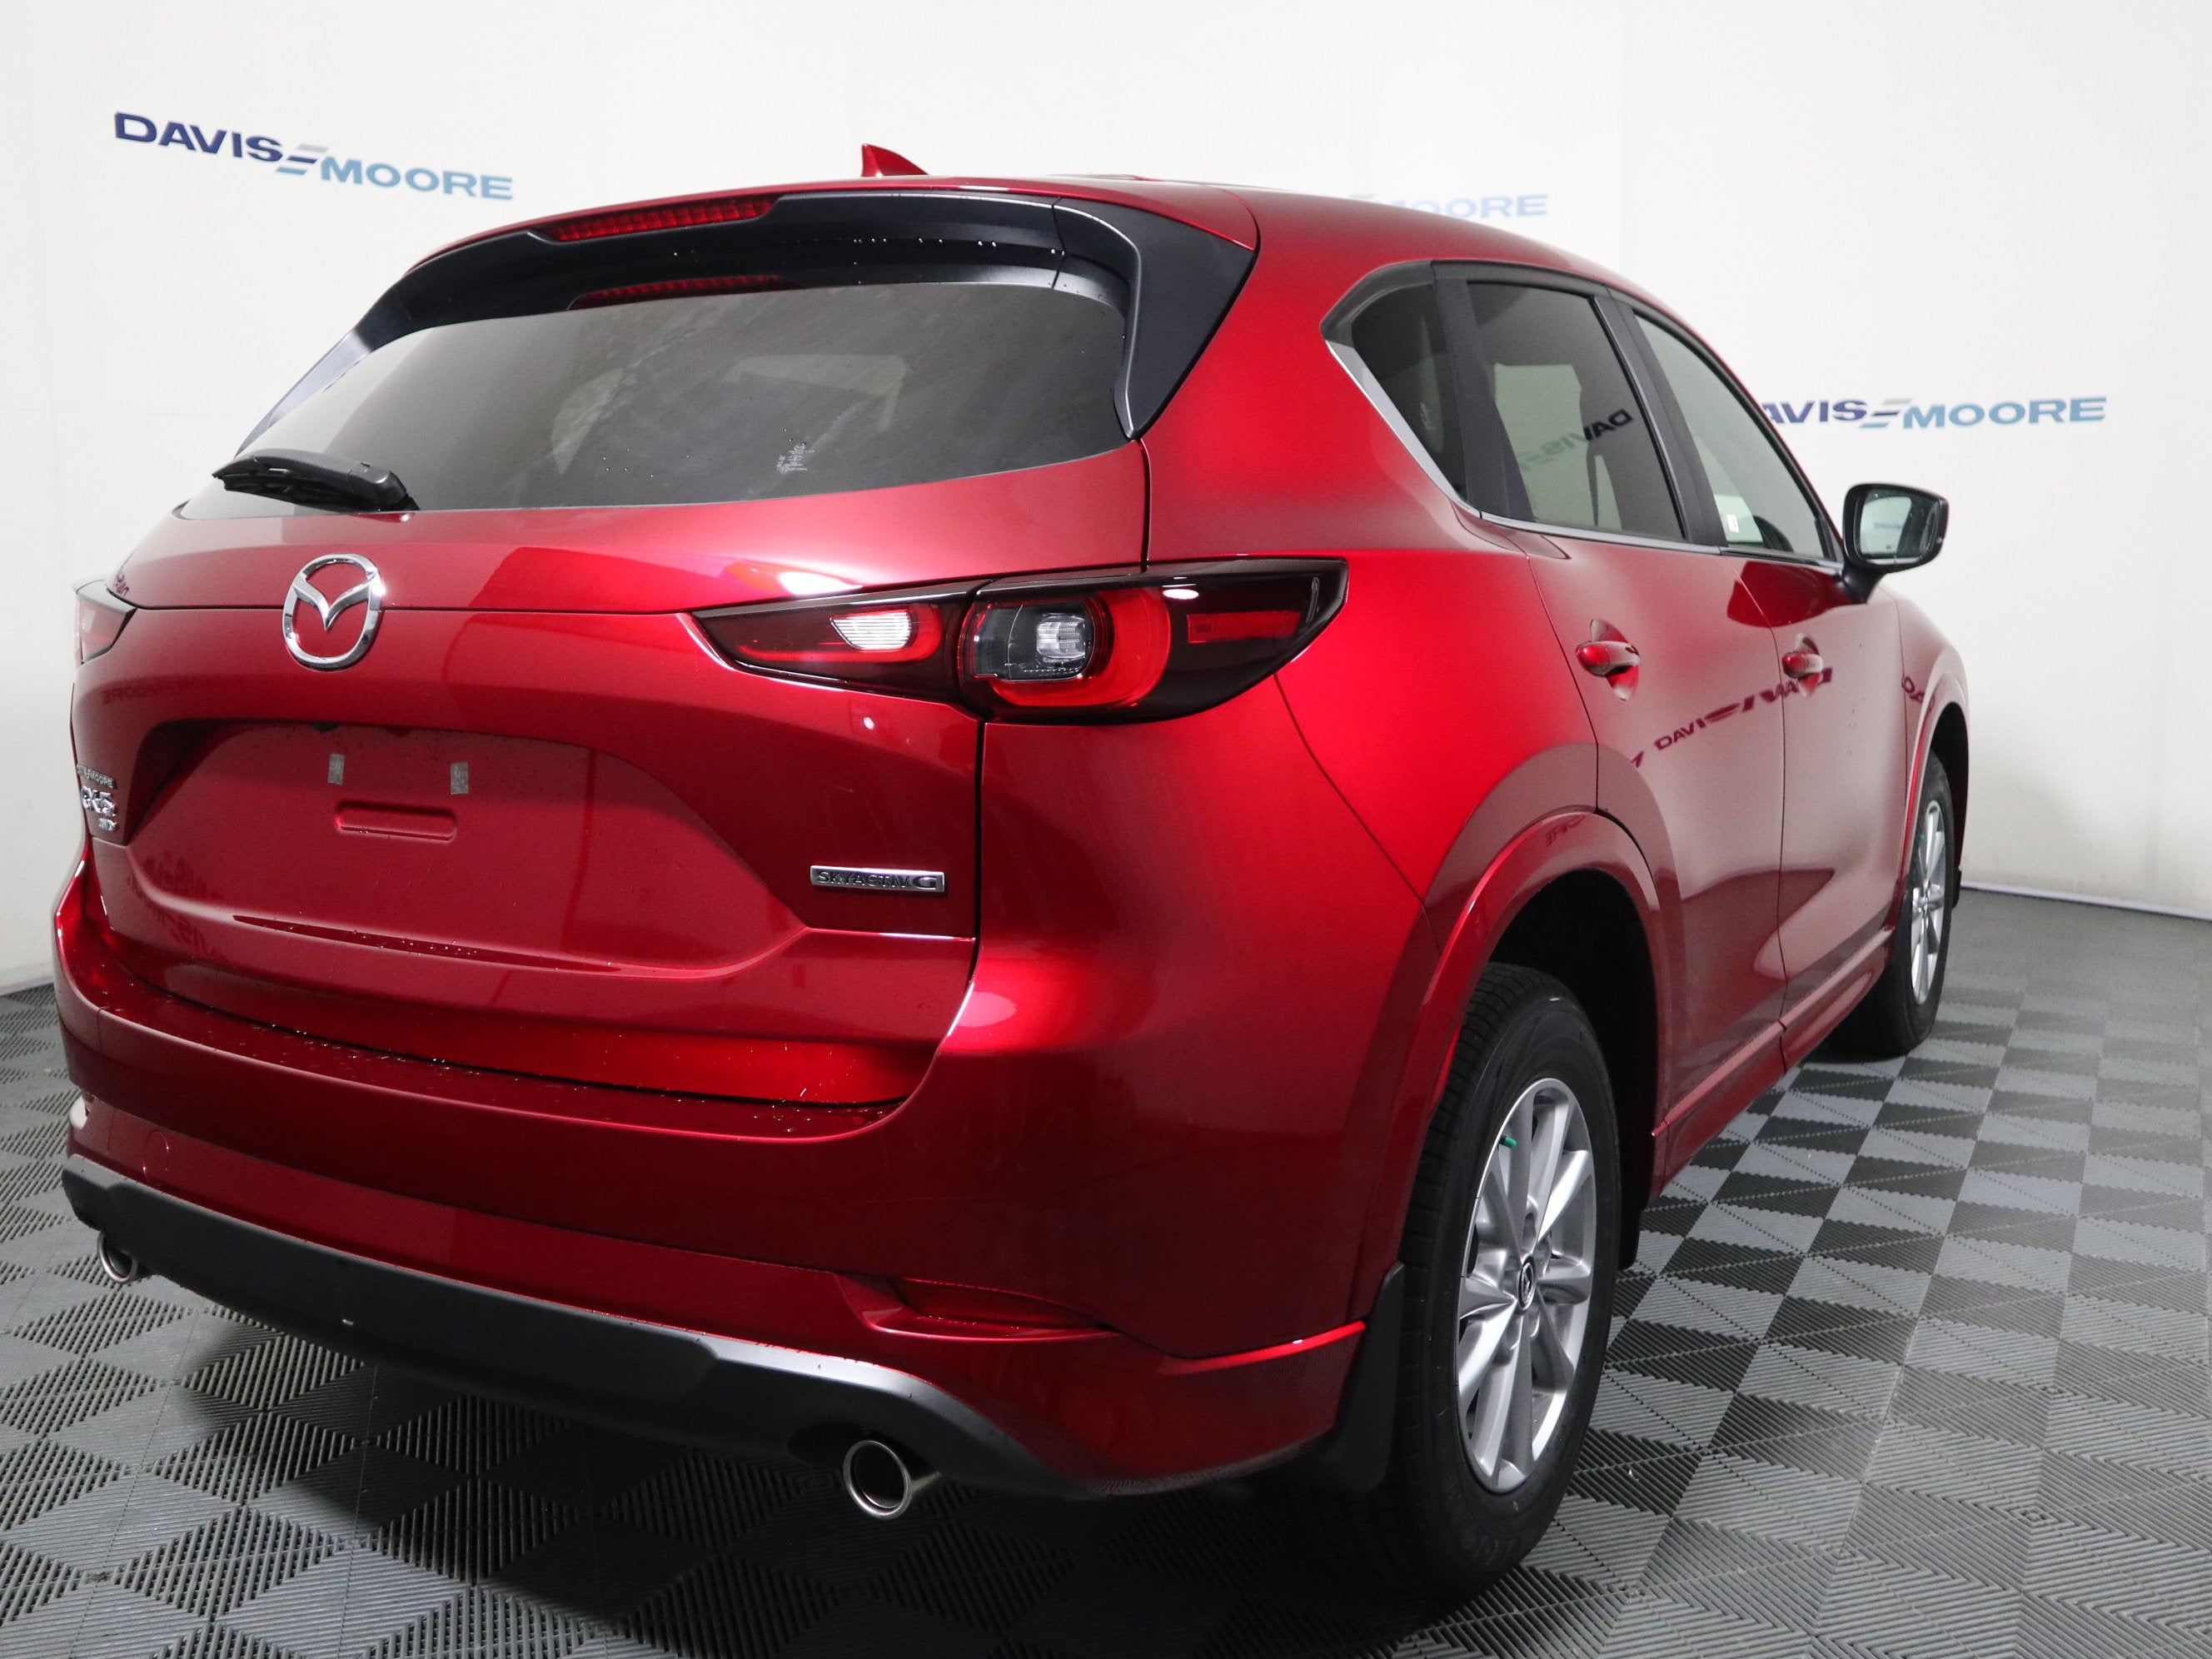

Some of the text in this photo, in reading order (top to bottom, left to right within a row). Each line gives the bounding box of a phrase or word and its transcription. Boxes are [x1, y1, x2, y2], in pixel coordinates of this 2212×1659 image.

[114, 112, 513, 200] DAVIS MOORE
[1761, 396, 2107, 429] AVIS MOORE
